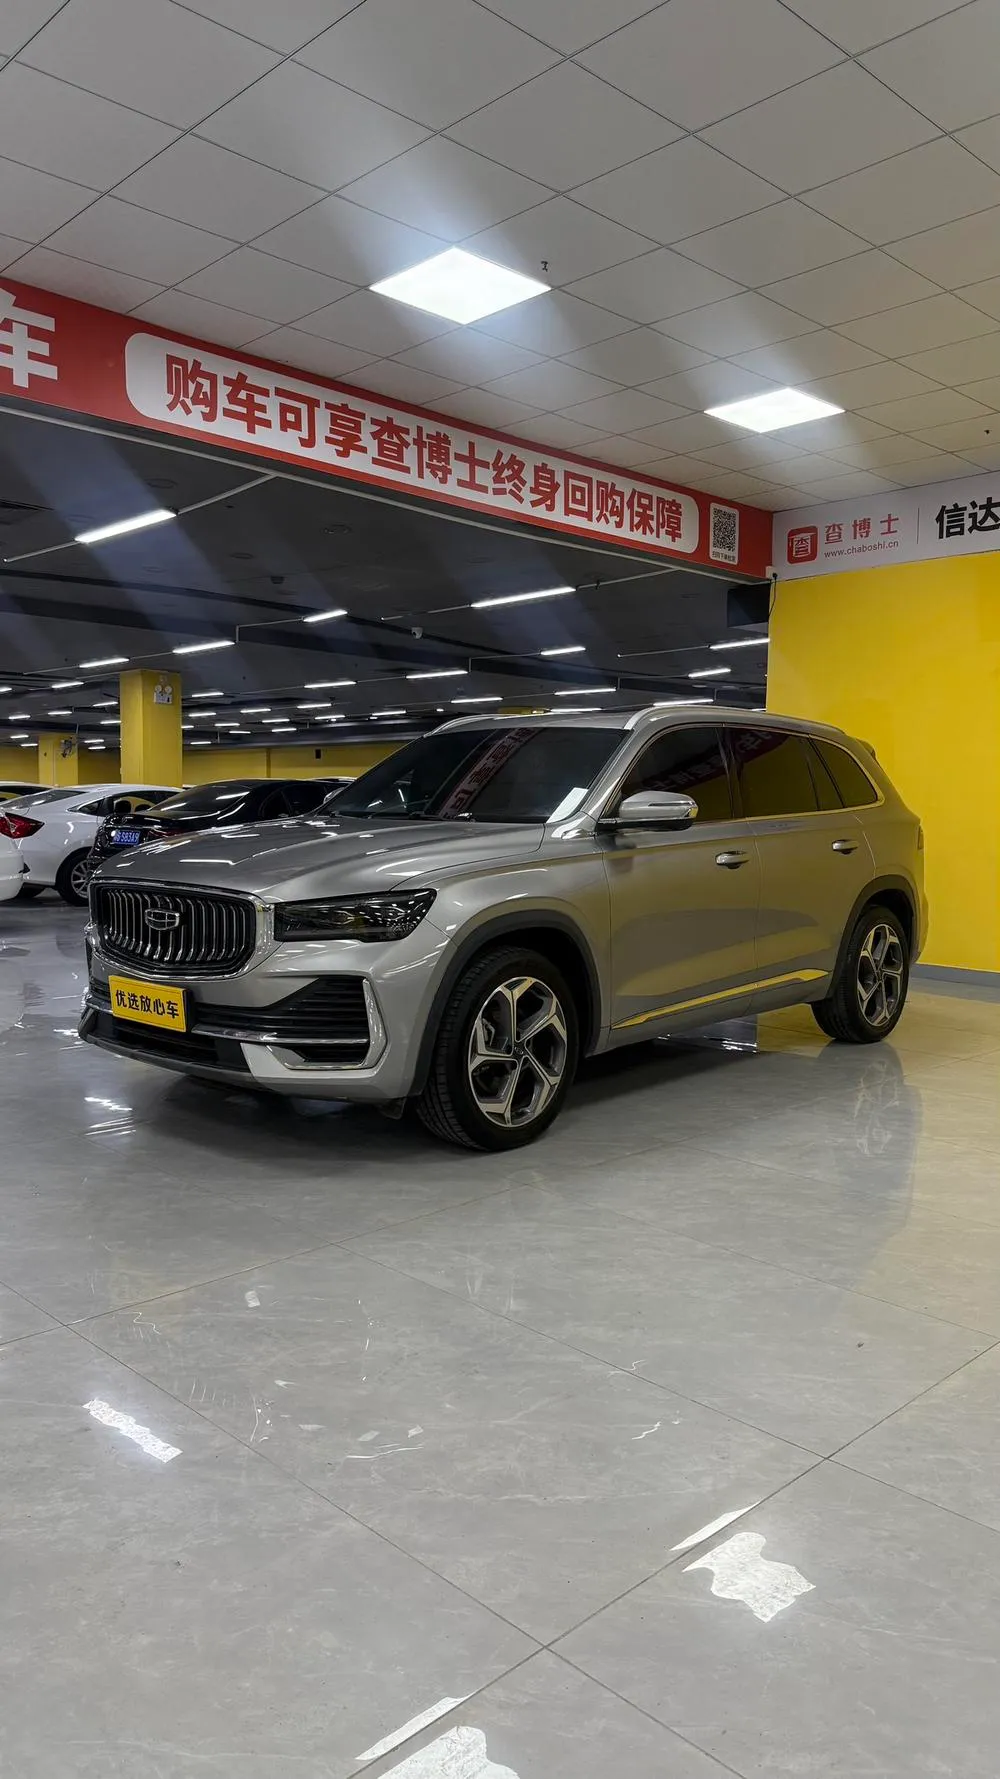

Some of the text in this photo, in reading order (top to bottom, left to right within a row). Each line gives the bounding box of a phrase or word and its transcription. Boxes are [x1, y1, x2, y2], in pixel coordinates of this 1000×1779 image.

[166, 353, 682, 543] 购车可享查博士终身回购保障
[824, 513, 900, 545] 查博士
[934, 496, 1000, 540] 信达
[824, 539, 899, 559] www.chaboshi.cn
[115, 989, 180, 1019] 优选放心车
